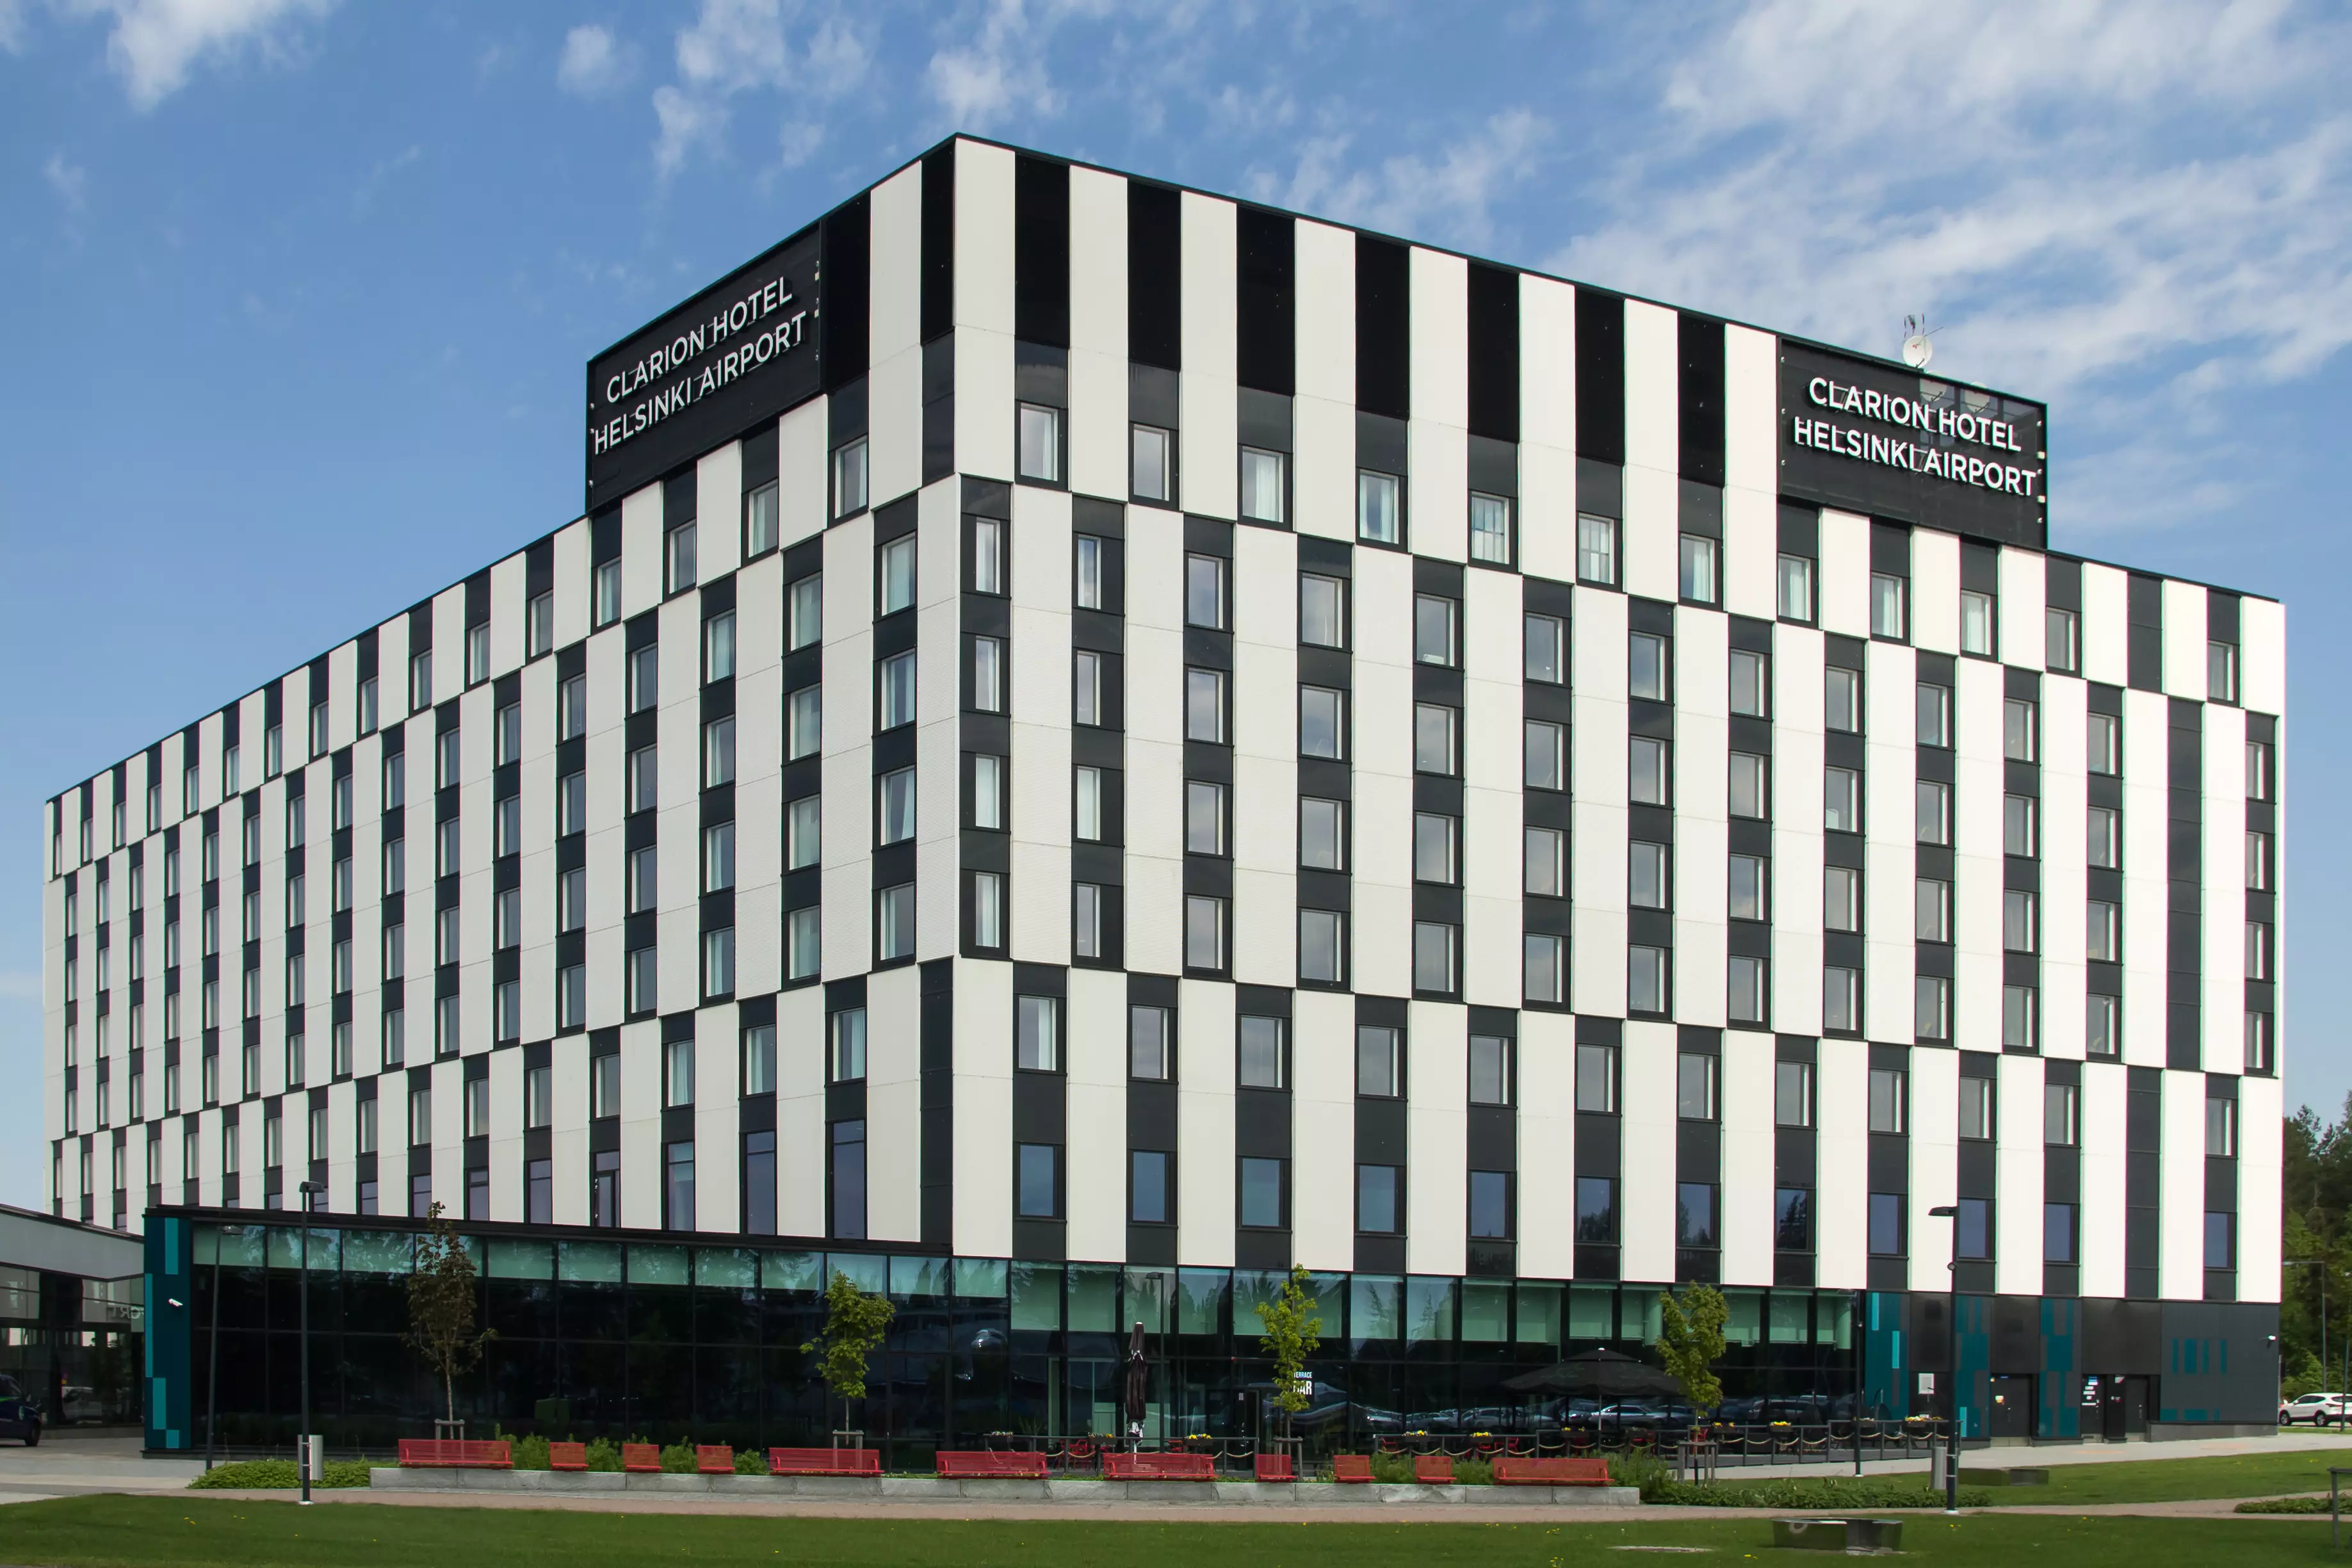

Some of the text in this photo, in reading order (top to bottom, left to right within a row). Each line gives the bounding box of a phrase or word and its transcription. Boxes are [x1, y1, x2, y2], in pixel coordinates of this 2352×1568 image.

[594, 310, 807, 455] HELSINKI AIRPORT
[606, 276, 793, 403] CLARION HOTEL
[1794, 416, 2037, 496] HELSINKI AIRPORT
[1808, 376, 2022, 452] CLARION HOTEL
